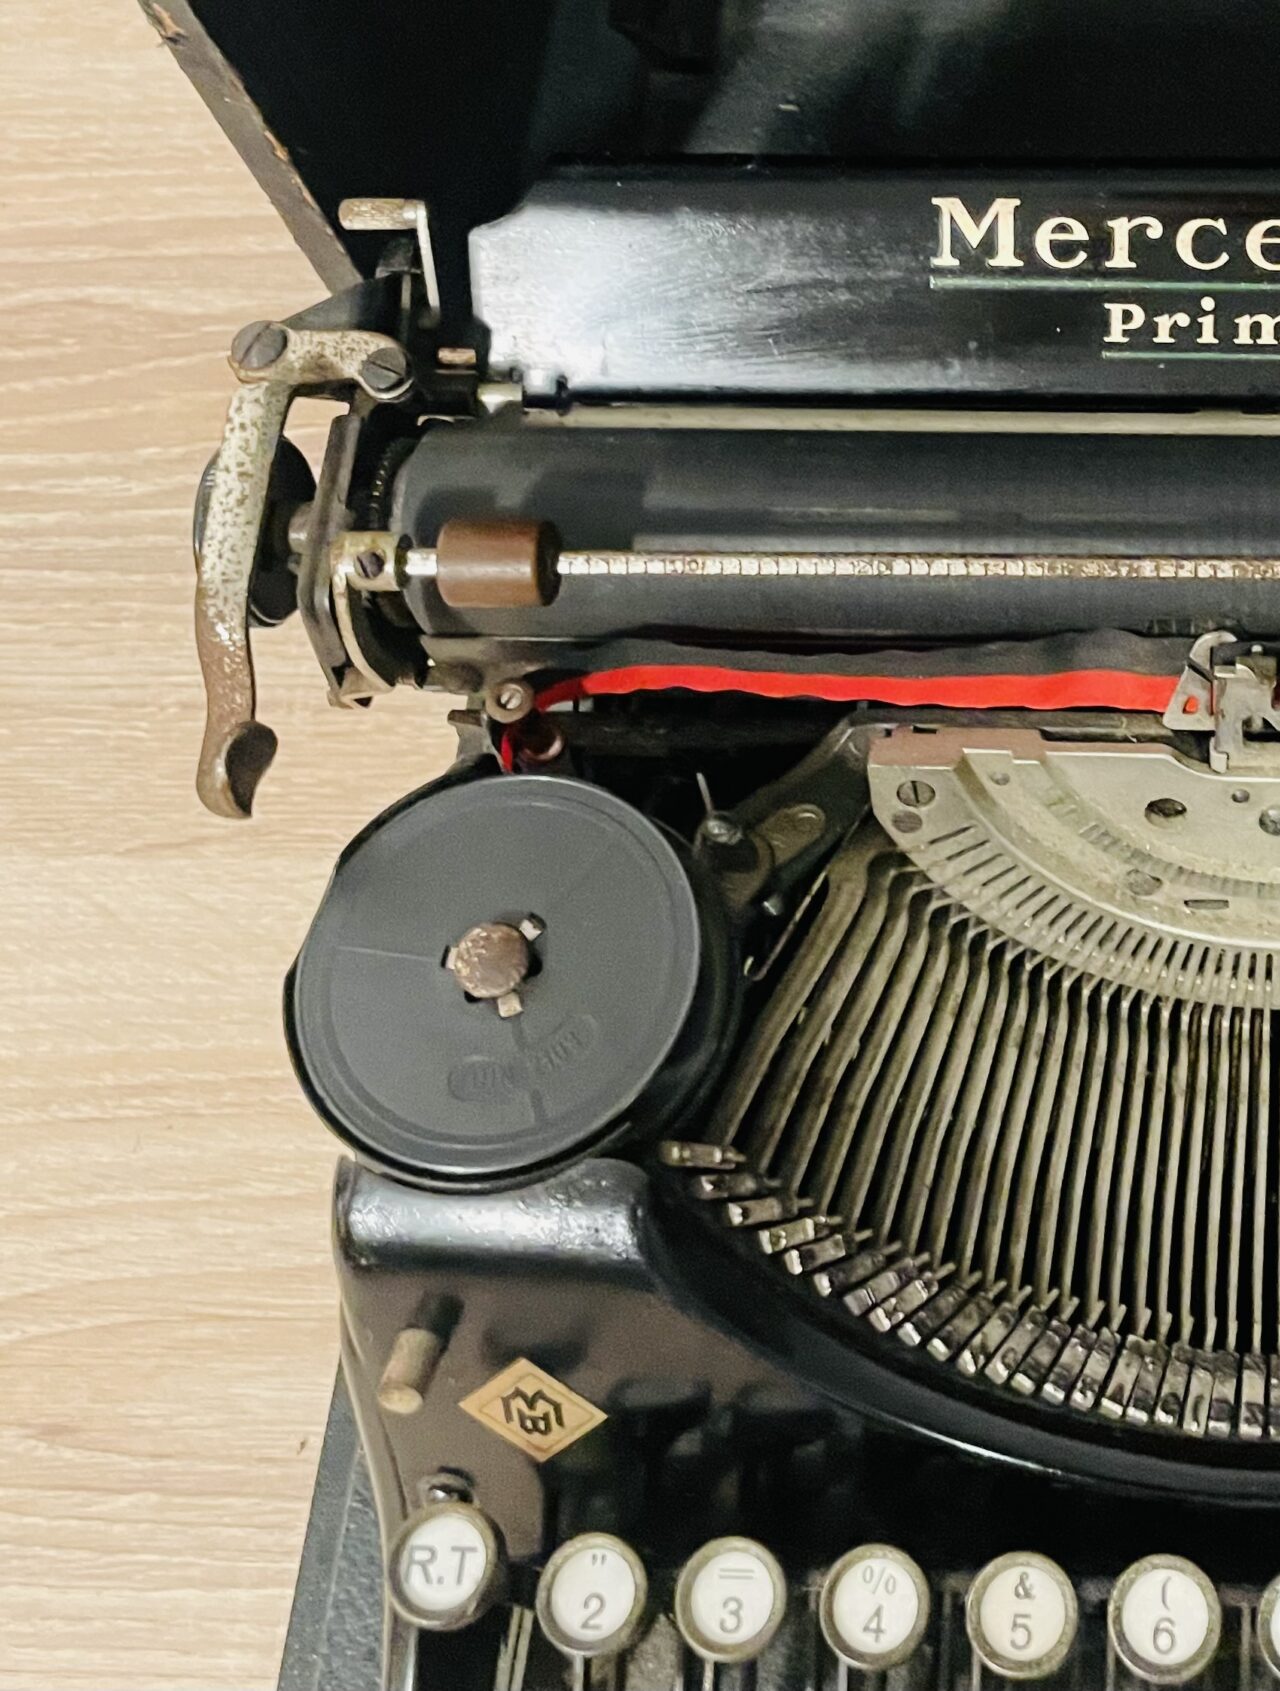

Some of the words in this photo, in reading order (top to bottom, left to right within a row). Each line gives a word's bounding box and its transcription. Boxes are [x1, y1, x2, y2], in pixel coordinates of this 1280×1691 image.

[404, 1544, 478, 1586] R.T
[1014, 1571, 1036, 1600] &
[580, 1592, 607, 1630] 2
[719, 1596, 744, 1634] 3
[862, 1603, 887, 1644] 4
[1010, 1613, 1032, 1651] 5
[1153, 1616, 1177, 1656] 6
